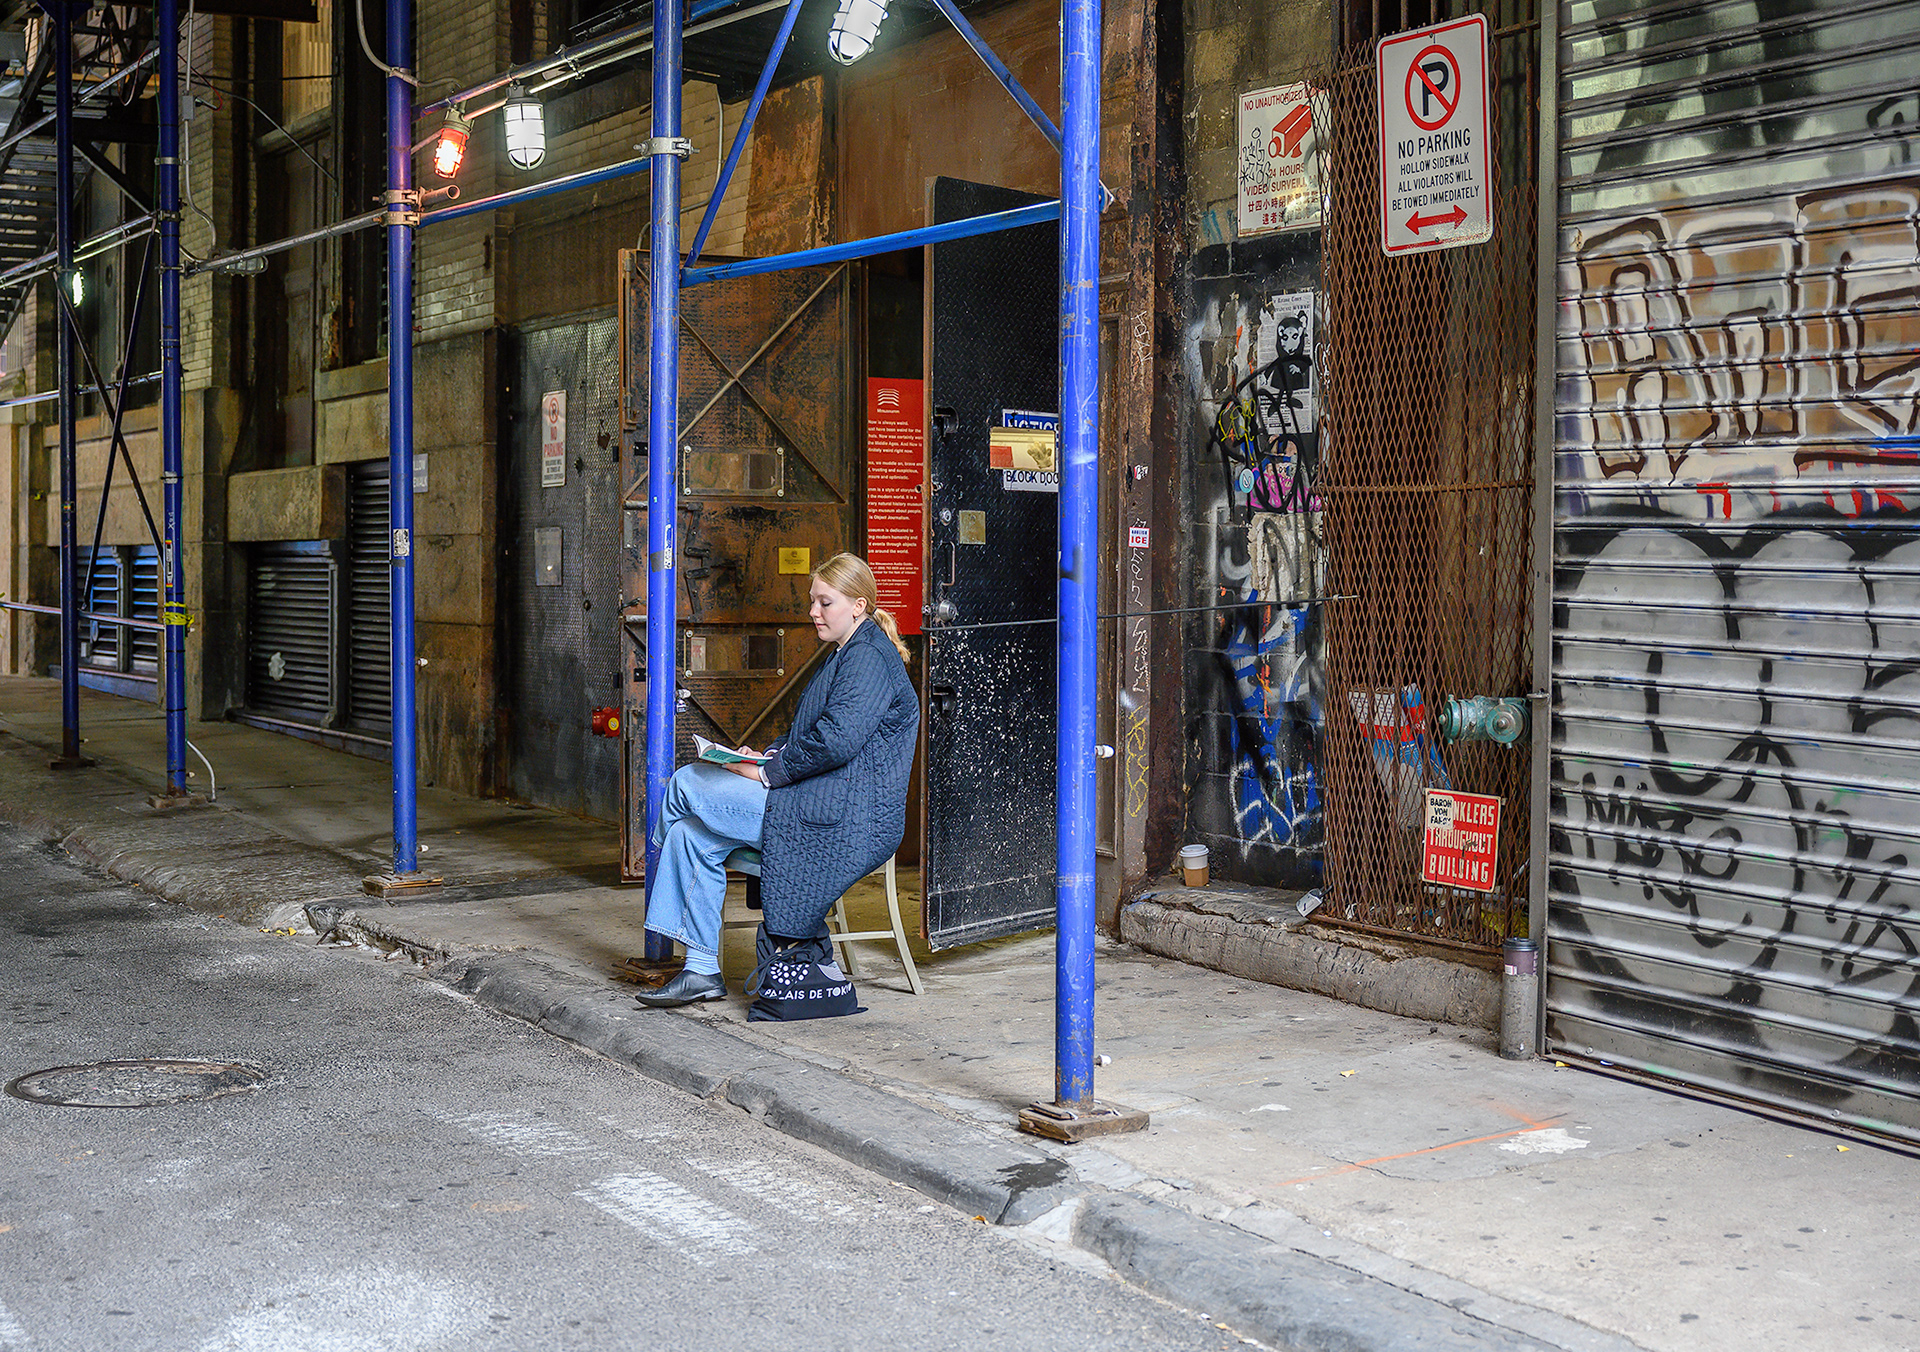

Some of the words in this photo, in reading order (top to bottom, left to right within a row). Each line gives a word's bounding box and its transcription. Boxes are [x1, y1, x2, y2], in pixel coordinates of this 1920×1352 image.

[1245, 100, 1253, 111] NO
[1255, 91, 1302, 109] UNAUTHORIZED
[1398, 139, 1414, 159] NO
[1418, 128, 1470, 155] PARKING
[1280, 162, 1305, 176] HOURS
[1401, 160, 1430, 176] HOLLOW
[1432, 152, 1469, 169] SIDEWALK
[1246, 184, 1268, 196] VIDEO
[1271, 175, 1316, 192] SURVEILL
[1398, 180, 1412, 193] ALL
[1413, 172, 1454, 190] VIOLATORS
[1456, 169, 1473, 182] WILL
[1392, 199, 1401, 211] BE
[1403, 194, 1428, 209] TOWED
[1430, 185, 1479, 204] IMMEDIATELY
[550, 426, 557, 440] NO
[1006, 470, 1037, 483] BLOCK
[1131, 536, 1147, 544] ICE
[1454, 801, 1495, 826] NKLERS
[1430, 827, 1493, 854] THROUGHOUT
[1429, 853, 1489, 883] BUILDING
[809, 989, 823, 999] DE
